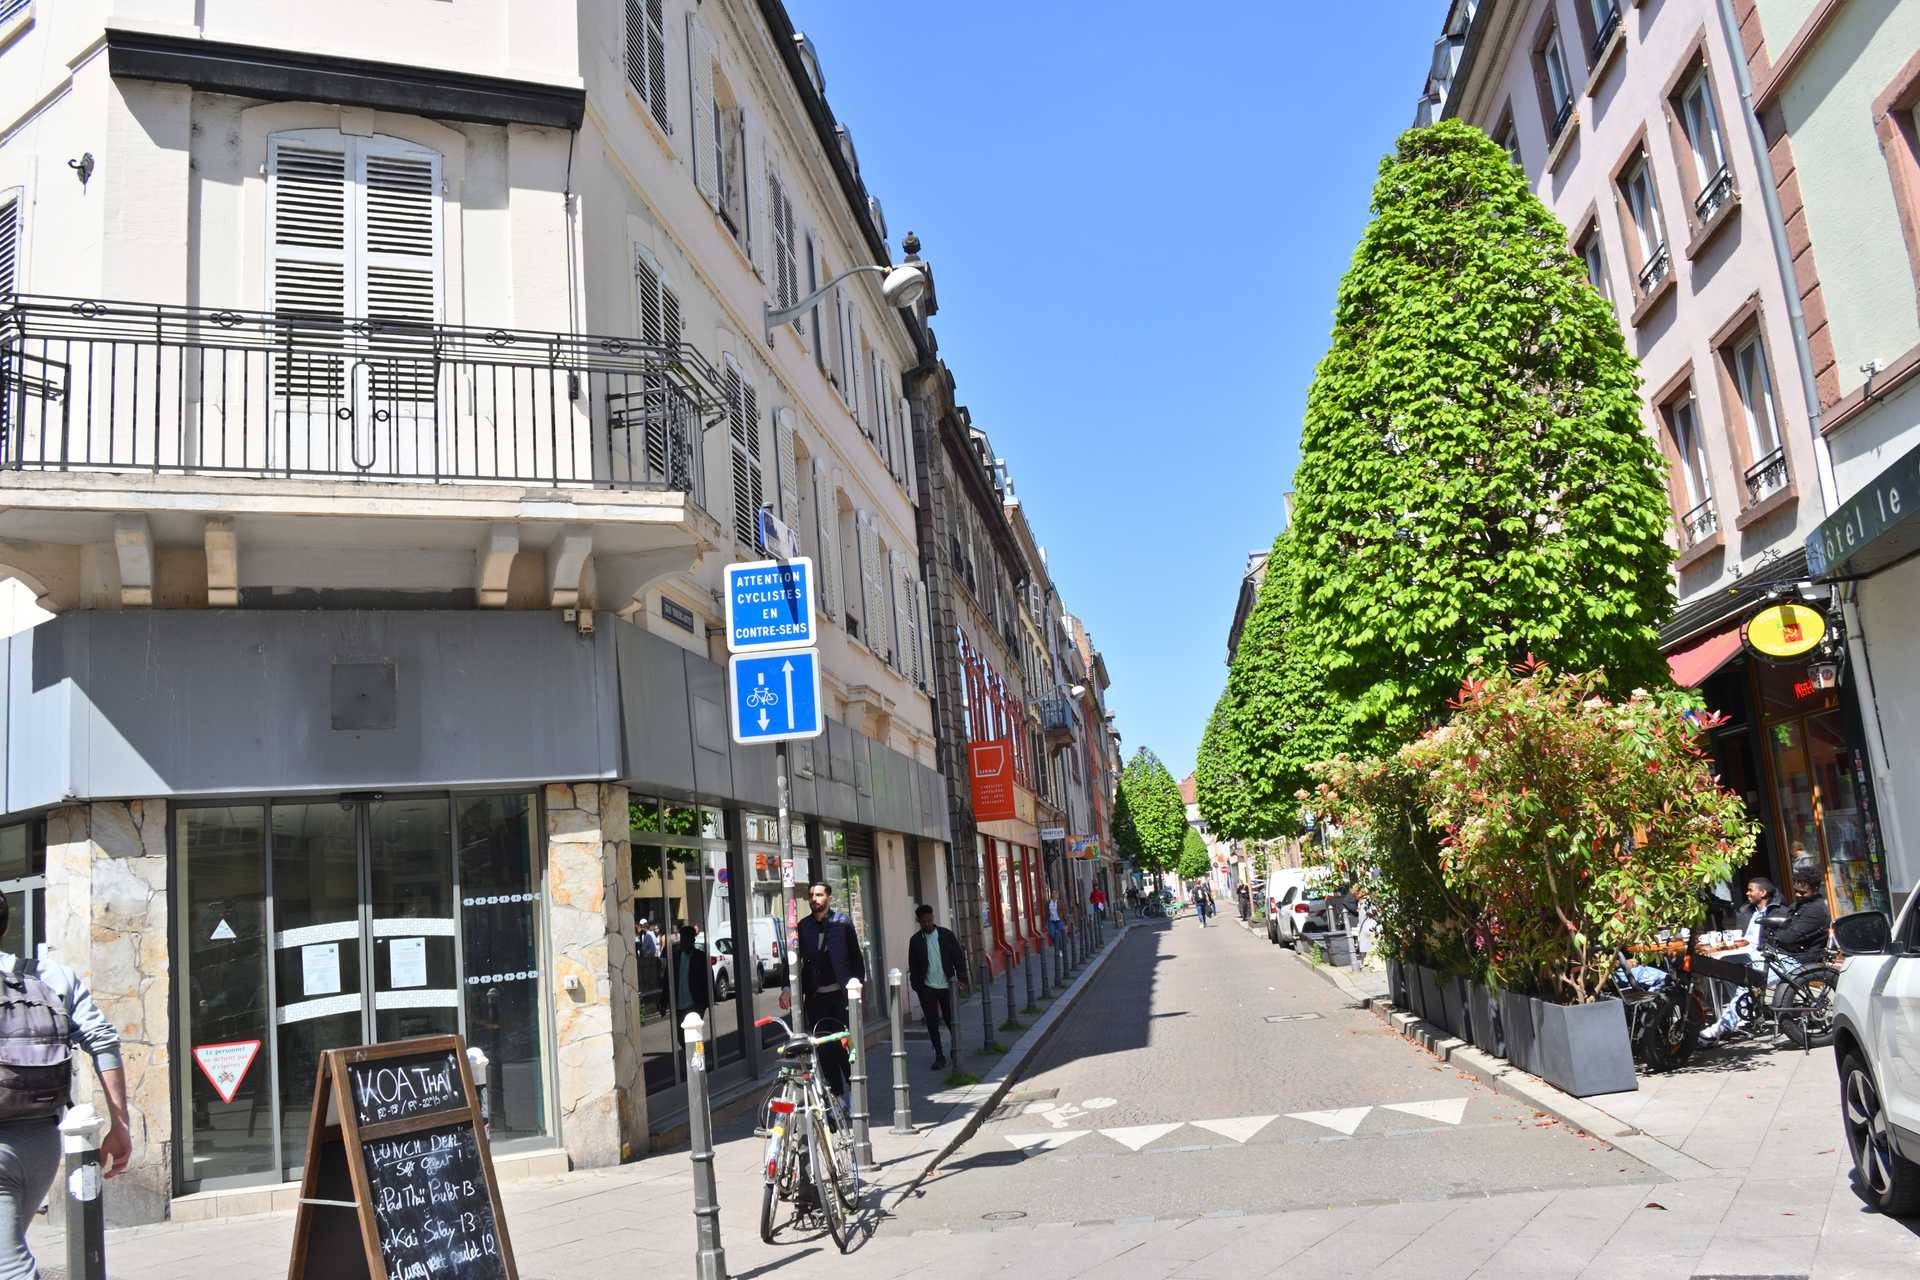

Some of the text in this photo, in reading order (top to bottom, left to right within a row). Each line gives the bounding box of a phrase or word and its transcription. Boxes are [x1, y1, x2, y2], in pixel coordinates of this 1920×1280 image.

[1816, 486, 1902, 566] hôtel le
[737, 571, 800, 587] ATTENTION
[737, 589, 802, 604] CYCLISTES
[763, 608, 778, 619] EN
[735, 622, 808, 639] CONTRE-SENS
[357, 1067, 417, 1107] KOA
[370, 1133, 463, 1167] LUNCH DEAL
[383, 1187, 402, 1213] Pad
[459, 1212, 476, 1233] 13
[482, 1233, 497, 1257] 12
